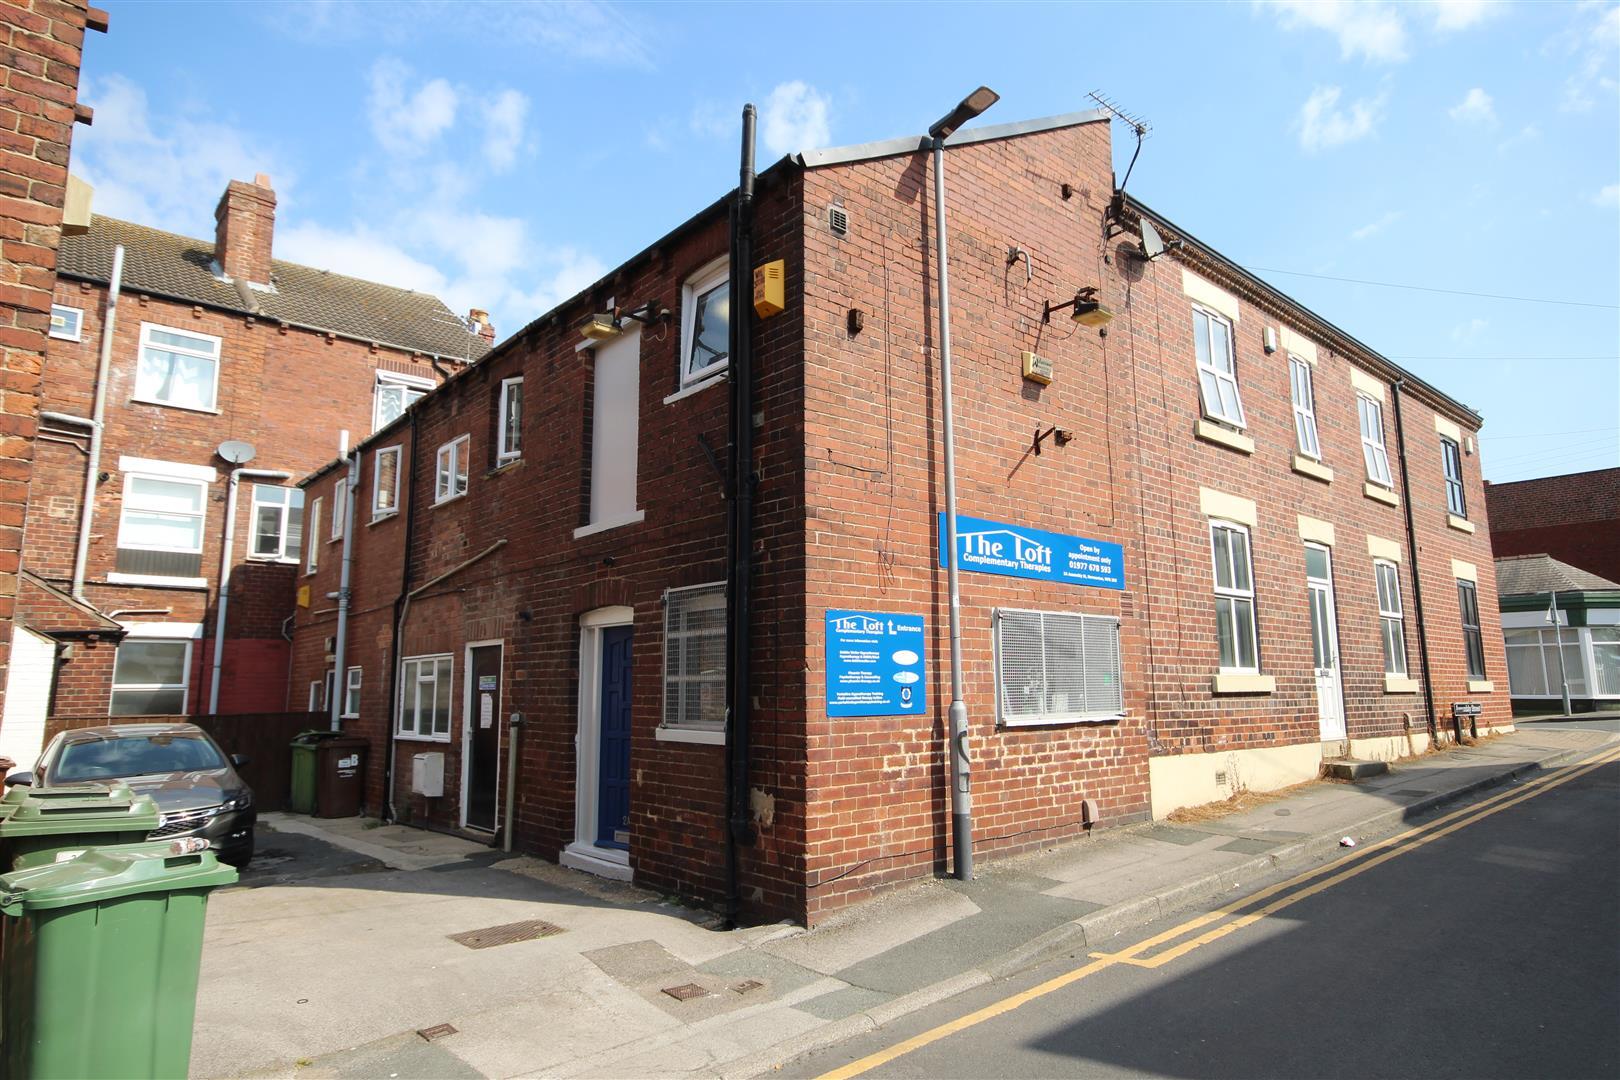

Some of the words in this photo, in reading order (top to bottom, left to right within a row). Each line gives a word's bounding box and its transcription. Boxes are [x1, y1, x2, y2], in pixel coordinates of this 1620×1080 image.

[965, 534, 1002, 558] The
[1015, 537, 1052, 564] Loft
[1080, 544, 1093, 553] Open
[1094, 546, 1100, 555] by
[963, 552, 1019, 569] Complementary
[1020, 560, 1051, 573] Therapies
[1068, 552, 1100, 563] appointment
[1100, 556, 1111, 565] only
[1069, 561, 1087, 570] 01977
[1089, 563, 1100, 572] 678
[1100, 565, 1111, 574] 593
[836, 620, 857, 630] The
[864, 619, 884, 631] Loft
